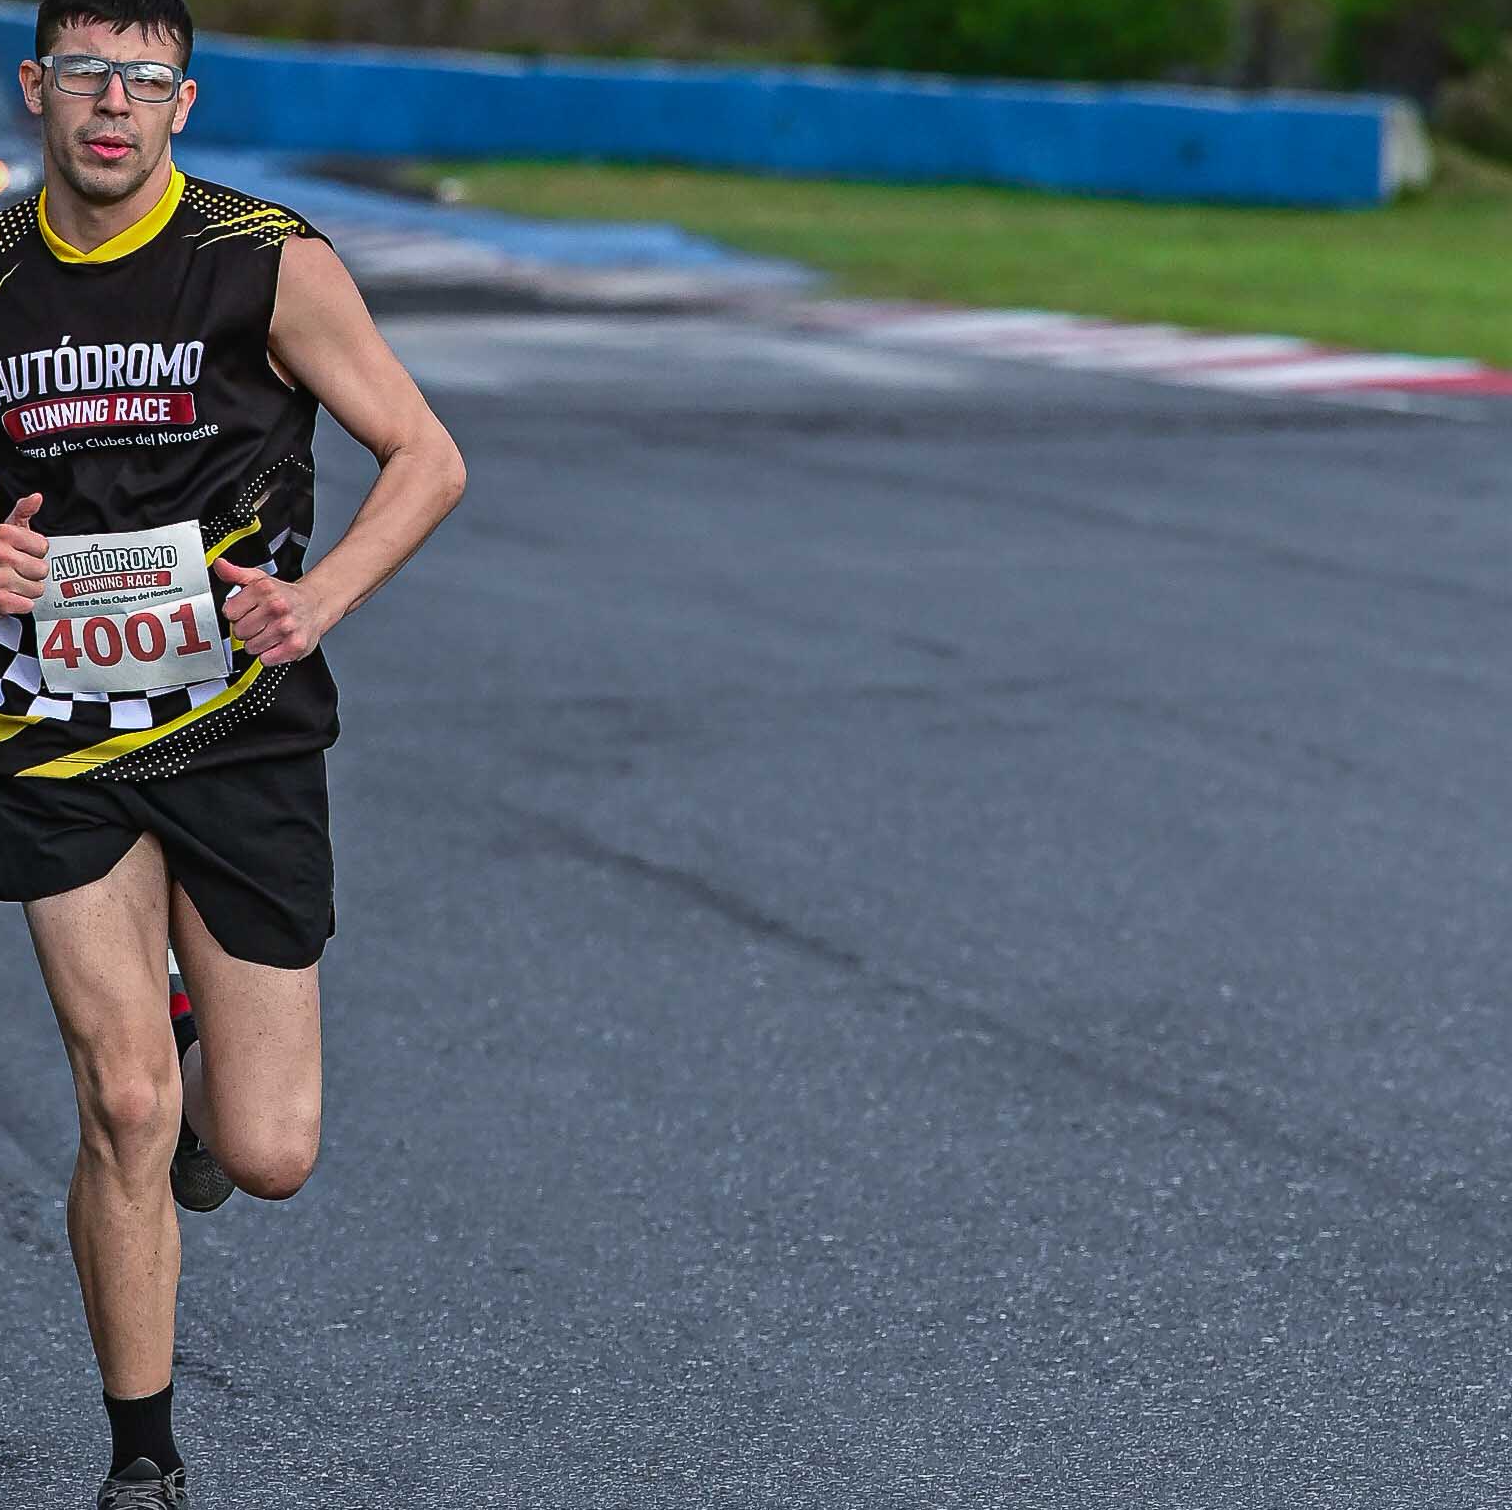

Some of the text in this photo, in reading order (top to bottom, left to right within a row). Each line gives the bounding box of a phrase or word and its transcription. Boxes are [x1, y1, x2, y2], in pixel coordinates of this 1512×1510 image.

[19, 397, 172, 435] RUNNING RACE
[62, 439, 84, 453] los
[86, 436, 133, 449] Clubes
[135, 433, 156, 447] del
[157, 423, 219, 446] Noroeste
[51, 544, 178, 582] AUTÓDROMO
[53, 586, 183, 609] La Carrera de los Clubes del Noroeste
[73, 573, 159, 595] RUNNING RACE
[41, 602, 212, 669] 4001
